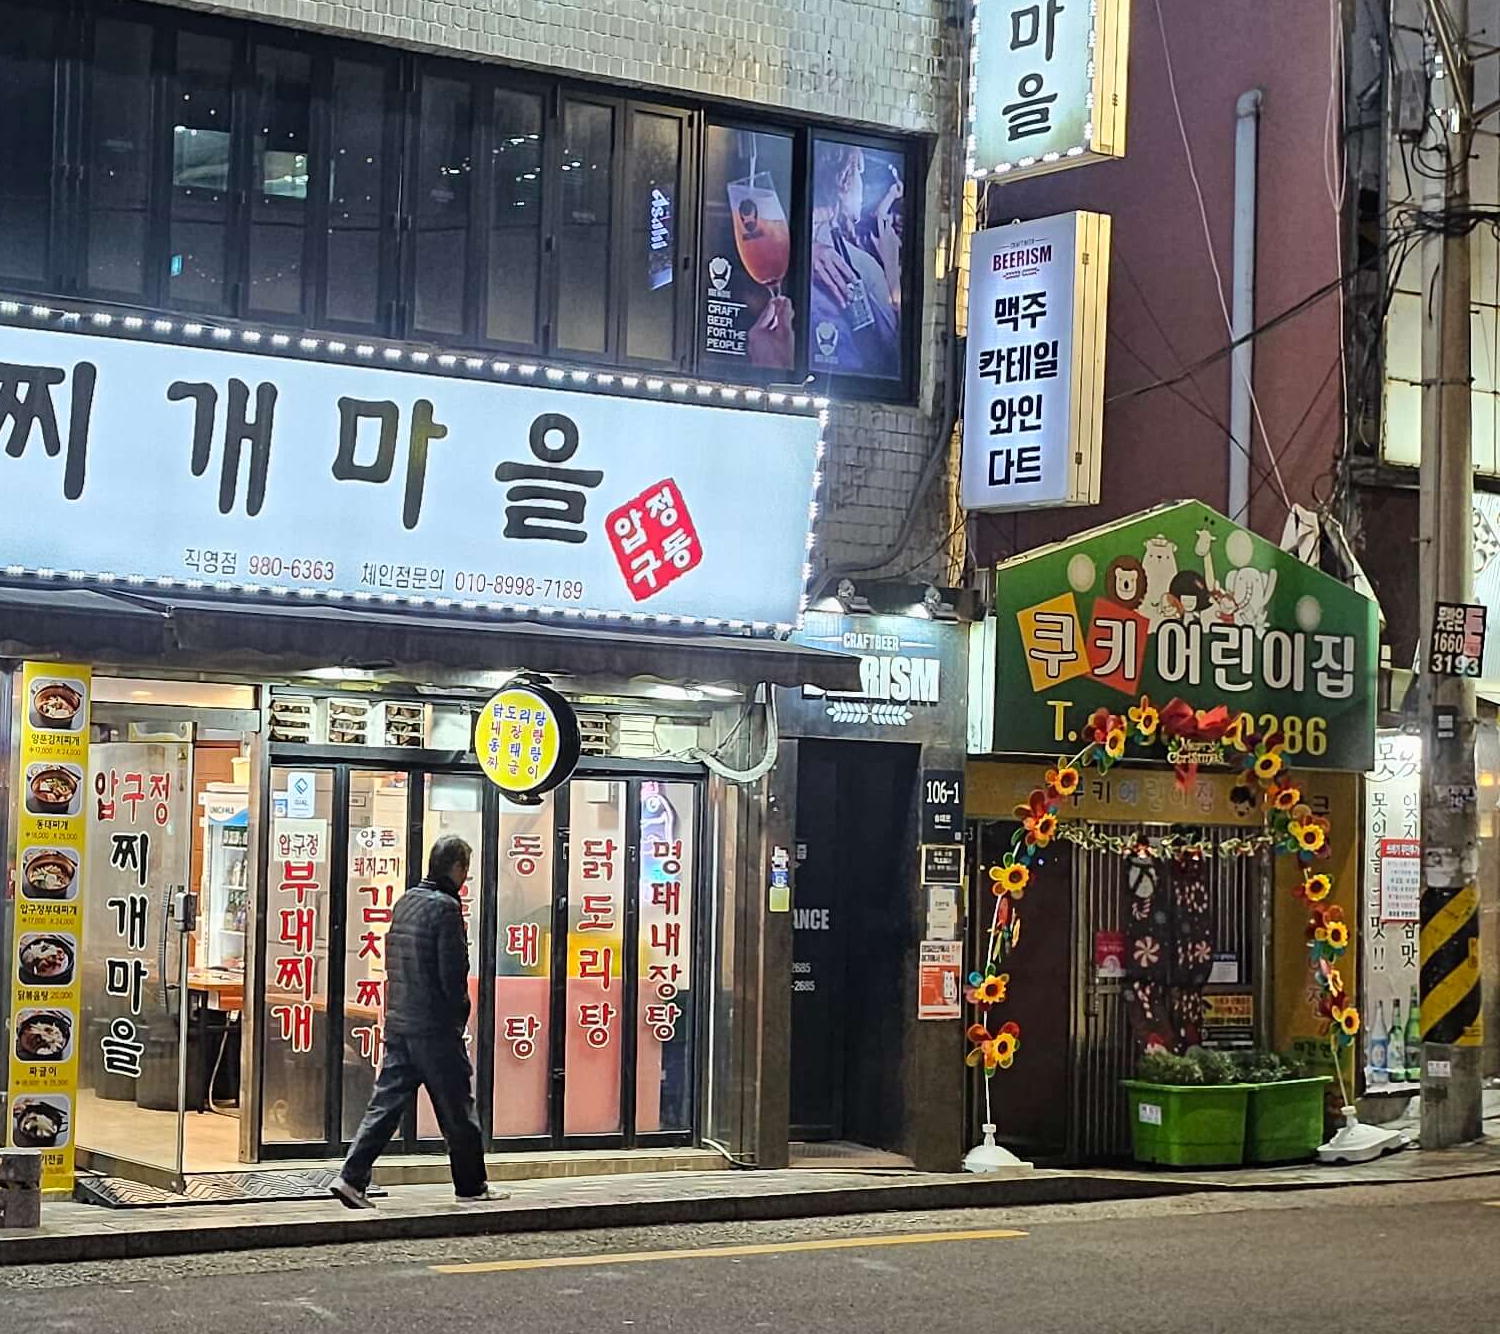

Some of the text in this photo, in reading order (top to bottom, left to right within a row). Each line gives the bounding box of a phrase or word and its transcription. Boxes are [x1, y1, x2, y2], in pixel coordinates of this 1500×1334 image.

[992, 245, 1052, 272] BEERISM
[707, 304, 740, 317] CRAFT
[707, 315, 733, 327] BEER
[994, 291, 1047, 331] 맥주
[706, 338, 745, 351] PEOPLE
[979, 340, 1059, 384] 칵테일
[989, 394, 1042, 435] 와인
[988, 445, 1041, 486] 다트
[184, 548, 335, 581] 직영점 980-6363
[361, 562, 584, 600] 체인점문의 010-8998-7189
[1029, 612, 1355, 709] 쿠키 어린이집
[1433, 632, 1463, 653] 1660
[1431, 654, 1480, 676] 3193
[1047, 700, 1077, 741] T.
[94, 769, 172, 828] 압구정
[926, 780, 960, 804] 106-1
[278, 832, 320, 857] 압구정
[360, 829, 397, 848] 양푼
[100, 831, 150, 1078] 찌개마을
[272, 859, 320, 1053] 부대찌개
[504, 834, 544, 1060] 동태탕
[577, 837, 619, 1048] 닭도리탕
[646, 838, 683, 1043] 명태내장탕
